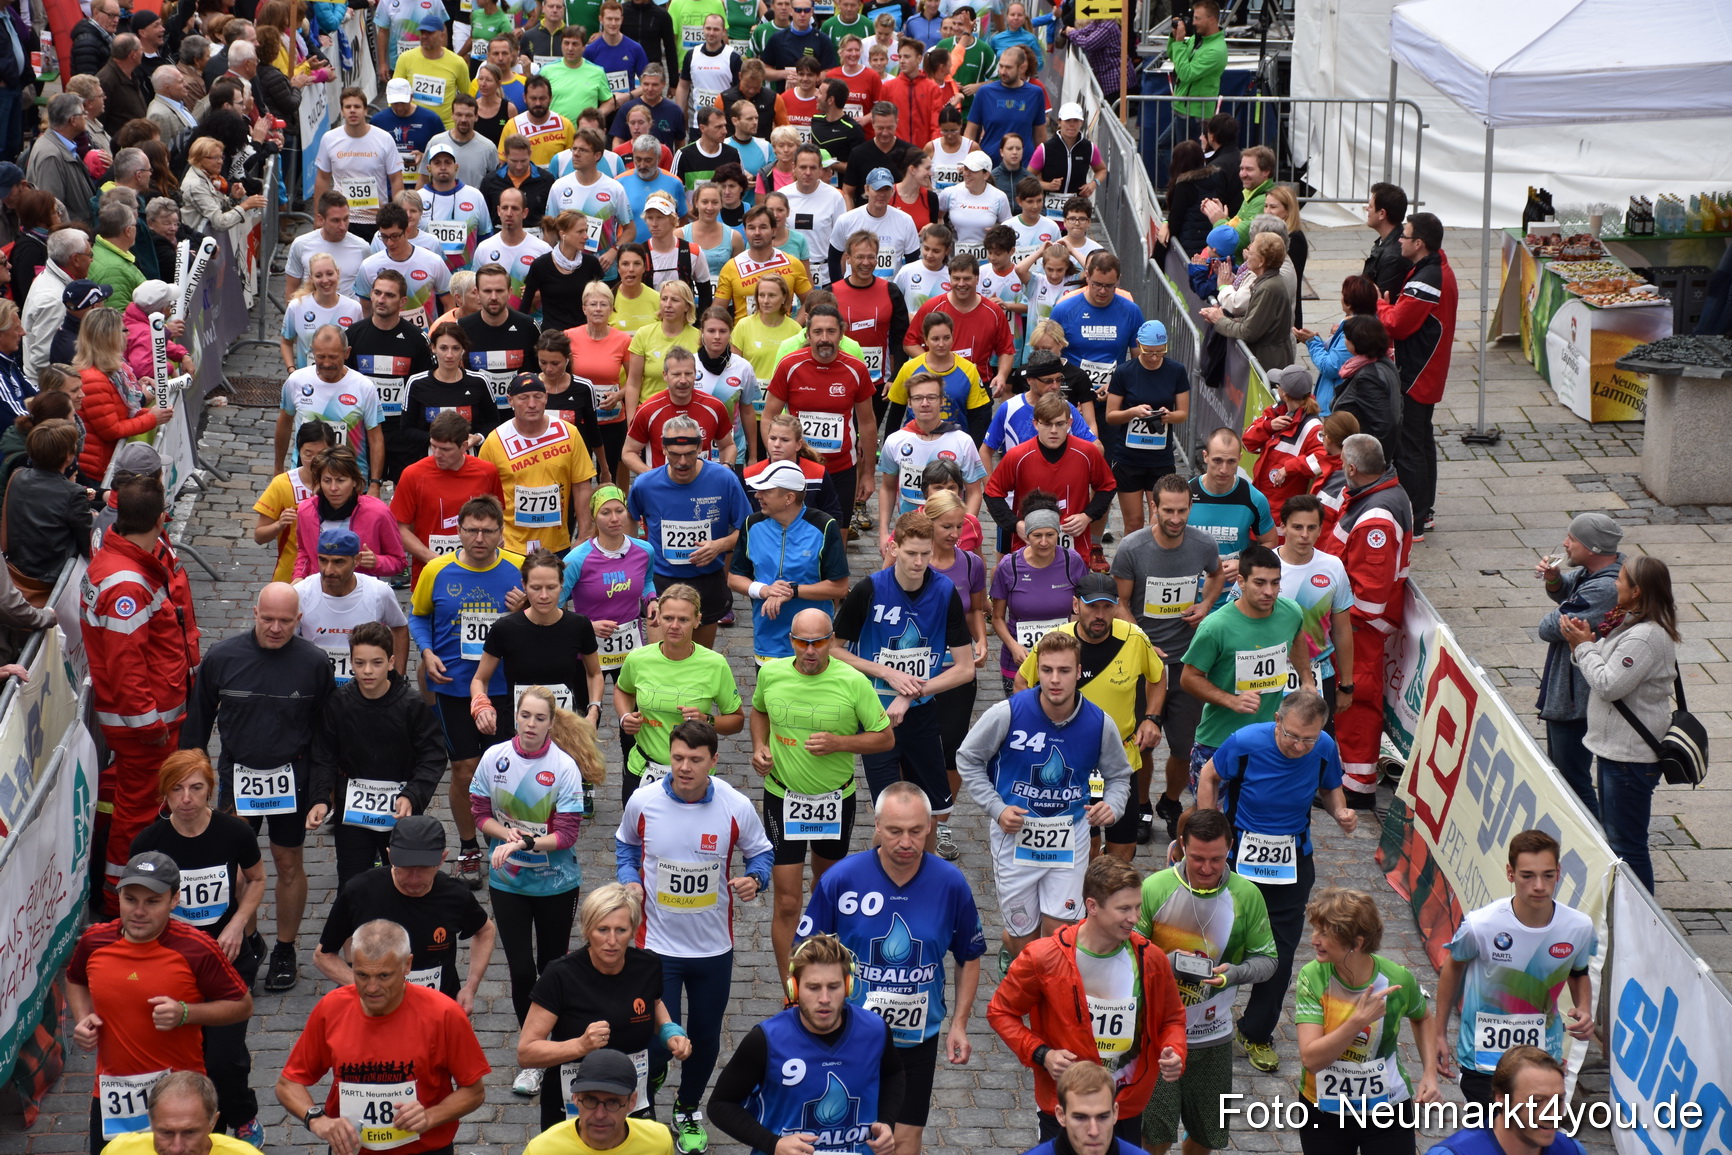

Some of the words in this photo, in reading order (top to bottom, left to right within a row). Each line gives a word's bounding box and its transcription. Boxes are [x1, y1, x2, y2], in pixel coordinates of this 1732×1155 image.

[415, 81, 442, 97] 2214
[336, 151, 374, 159] Continental
[938, 172, 964, 183] 2405
[349, 185, 371, 199] 359
[433, 229, 464, 243] 3064
[1081, 325, 1118, 334] HUBER
[154, 336, 167, 367] BMW
[815, 414, 837, 423] Neumarkt
[803, 422, 838, 440] 2781
[808, 440, 832, 449] Berthold
[1141, 437, 1154, 445] Anni
[510, 455, 540, 473] MAX
[516, 488, 531, 498] PARTL
[531, 490, 554, 498] Neumarkt
[520, 495, 556, 513] 2779
[531, 514, 545, 523] Ralf
[667, 531, 708, 549] 2238
[602, 570, 627, 586] RUN
[1147, 580, 1166, 588] PARTL
[1166, 580, 1190, 588] Neumarkt
[1162, 588, 1181, 604] 51
[872, 604, 902, 626] 14
[1160, 606, 1181, 615] Tobias
[462, 616, 480, 624] PARTL
[1018, 622, 1035, 632] PARTL
[604, 633, 635, 654] 313
[881, 652, 898, 661] PARTL
[900, 652, 923, 662] Neumarkt
[1236, 653, 1256, 663] PARTL
[1257, 650, 1281, 661] Neumarkt
[1253, 658, 1276, 679] 40
[1249, 678, 1278, 691] Michael
[1009, 730, 1047, 753] 24
[537, 774, 554, 784] Hervis
[240, 774, 290, 797] 2519
[349, 782, 370, 792] PARTL
[369, 784, 397, 793] Neumarkt
[352, 791, 398, 813] 2520
[786, 793, 805, 803] PARTL
[249, 799, 281, 811] Guenter
[1033, 801, 1065, 809] BASKETS
[790, 801, 837, 822] 2343
[362, 815, 387, 827] Marko
[1039, 821, 1066, 831] Neumarkt
[799, 824, 823, 834] Benno
[1021, 828, 1071, 850] 2527
[1244, 834, 1263, 846] PARTL
[1031, 851, 1058, 862] Fabian
[1245, 844, 1292, 866] 2830
[659, 862, 680, 873] PARTL
[681, 865, 712, 876] Neumarkt
[1254, 867, 1279, 879] Volker
[183, 873, 218, 884] Neumarkt
[669, 873, 710, 895] 509
[181, 881, 224, 907] 167
[662, 895, 698, 907] FLORIAN
[837, 890, 885, 918] 60
[182, 909, 211, 922] Gisela
[1491, 951, 1513, 960] PARTL
[1552, 946, 1571, 955] Hervis
[858, 963, 936, 985] FIBALON
[875, 985, 913, 994] BASKETS
[867, 997, 889, 1006] PARTL
[889, 998, 920, 1008] Neumarkt
[1094, 1003, 1127, 1012] Neumarkt
[1090, 1012, 1124, 1036] 16
[1477, 1017, 1502, 1026] PARTL
[1502, 1019, 1535, 1028] Neumarkt
[1482, 1026, 1540, 1052] 3098
[781, 1057, 807, 1086] 9
[1341, 1066, 1376, 1077] Neumarkt
[105, 1079, 128, 1090] PARTL
[129, 1077, 163, 1090] Neumarkt
[1323, 1074, 1384, 1099] 2475
[340, 1089, 365, 1100] PARTL
[366, 1090, 403, 1101] Neumarkt
[112, 1088, 154, 1117] 311
[363, 1100, 394, 1126] 48
[367, 1131, 393, 1143] Erich
